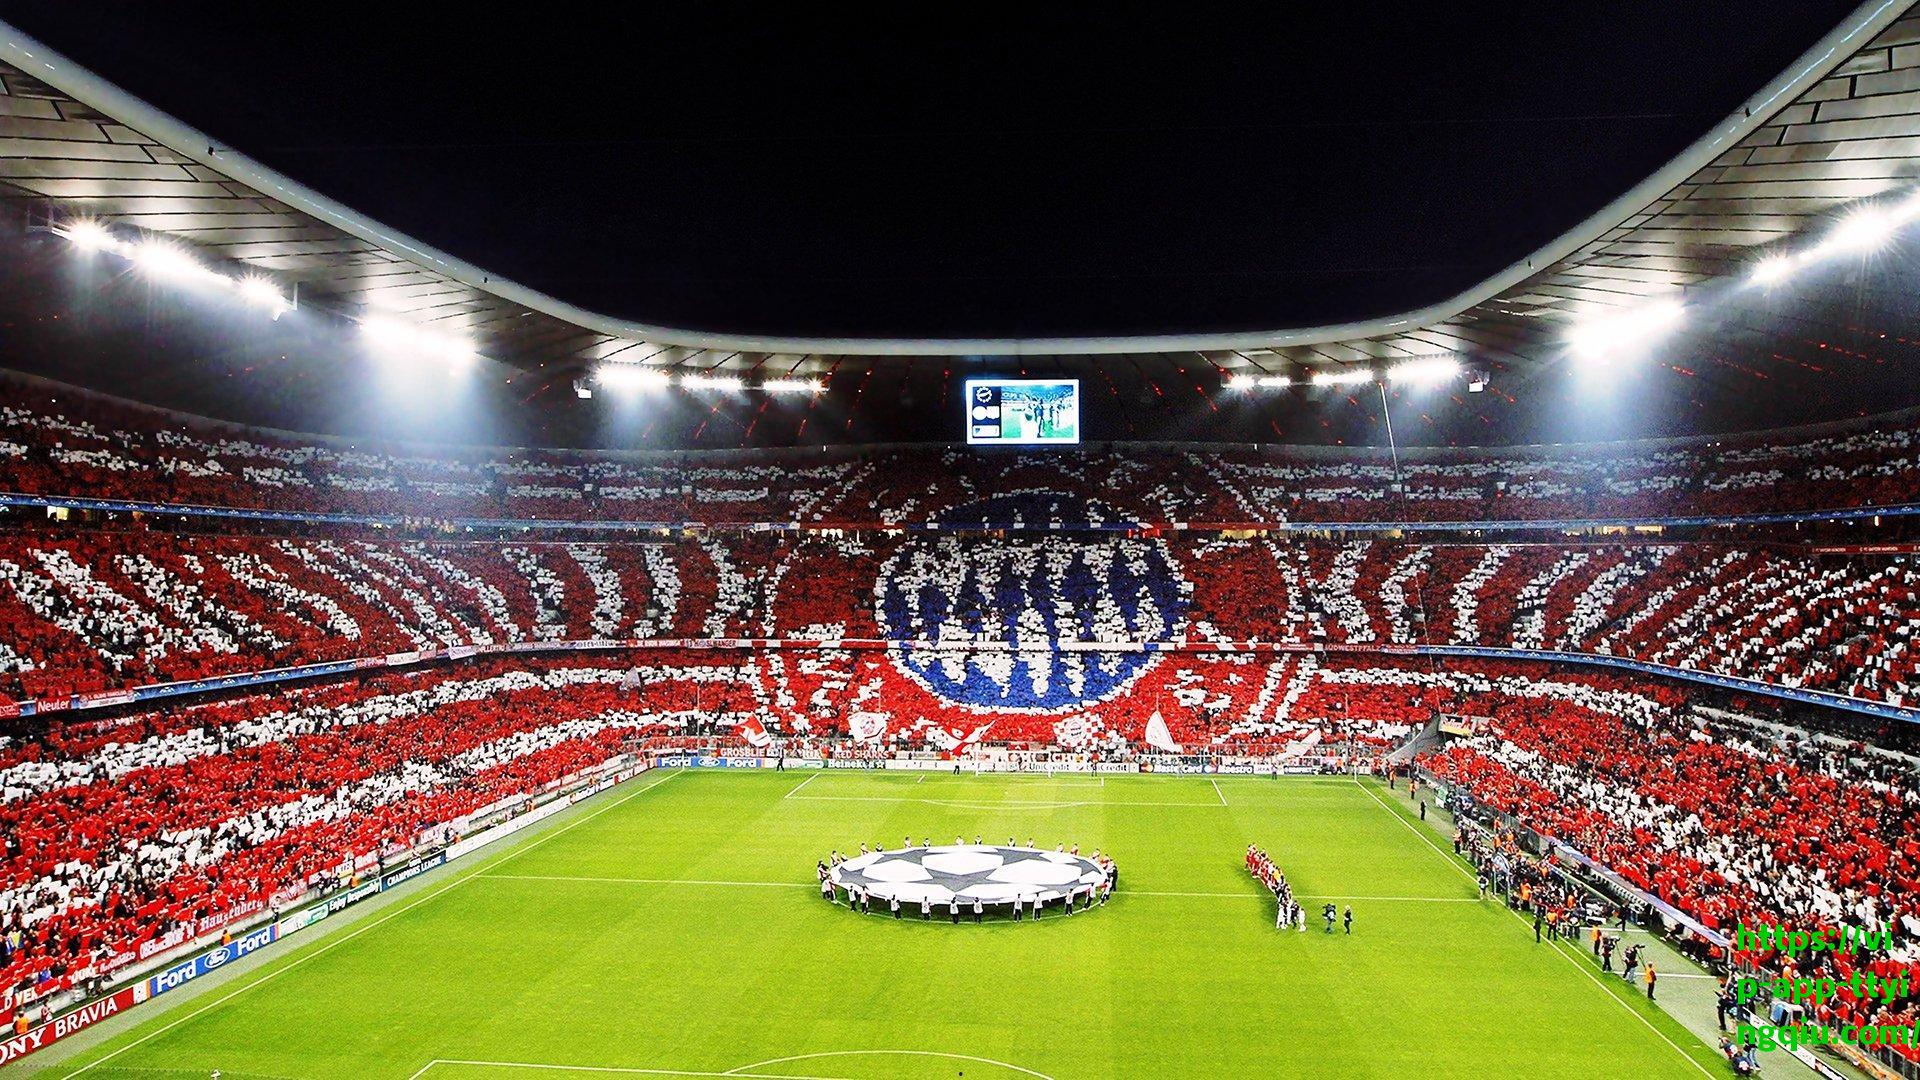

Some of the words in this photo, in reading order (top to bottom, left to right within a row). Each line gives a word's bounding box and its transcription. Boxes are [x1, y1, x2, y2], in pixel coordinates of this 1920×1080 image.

[37, 699, 70, 713] Neuler
[855, 750, 889, 759] SHARKS
[661, 757, 692, 767] Ford
[726, 757, 757, 768] Ford
[1029, 763, 1070, 771] UniCedit
[1087, 763, 1127, 771] UiCredit
[1154, 764, 1203, 773] MasteCard
[387, 865, 421, 886] CHAMPIONS
[421, 856, 442, 872] LEAGUE
[329, 896, 347, 912] Enjoy
[238, 928, 270, 956] Ford
[157, 959, 197, 993] Ford
[55, 996, 118, 1039] BRAVIA
